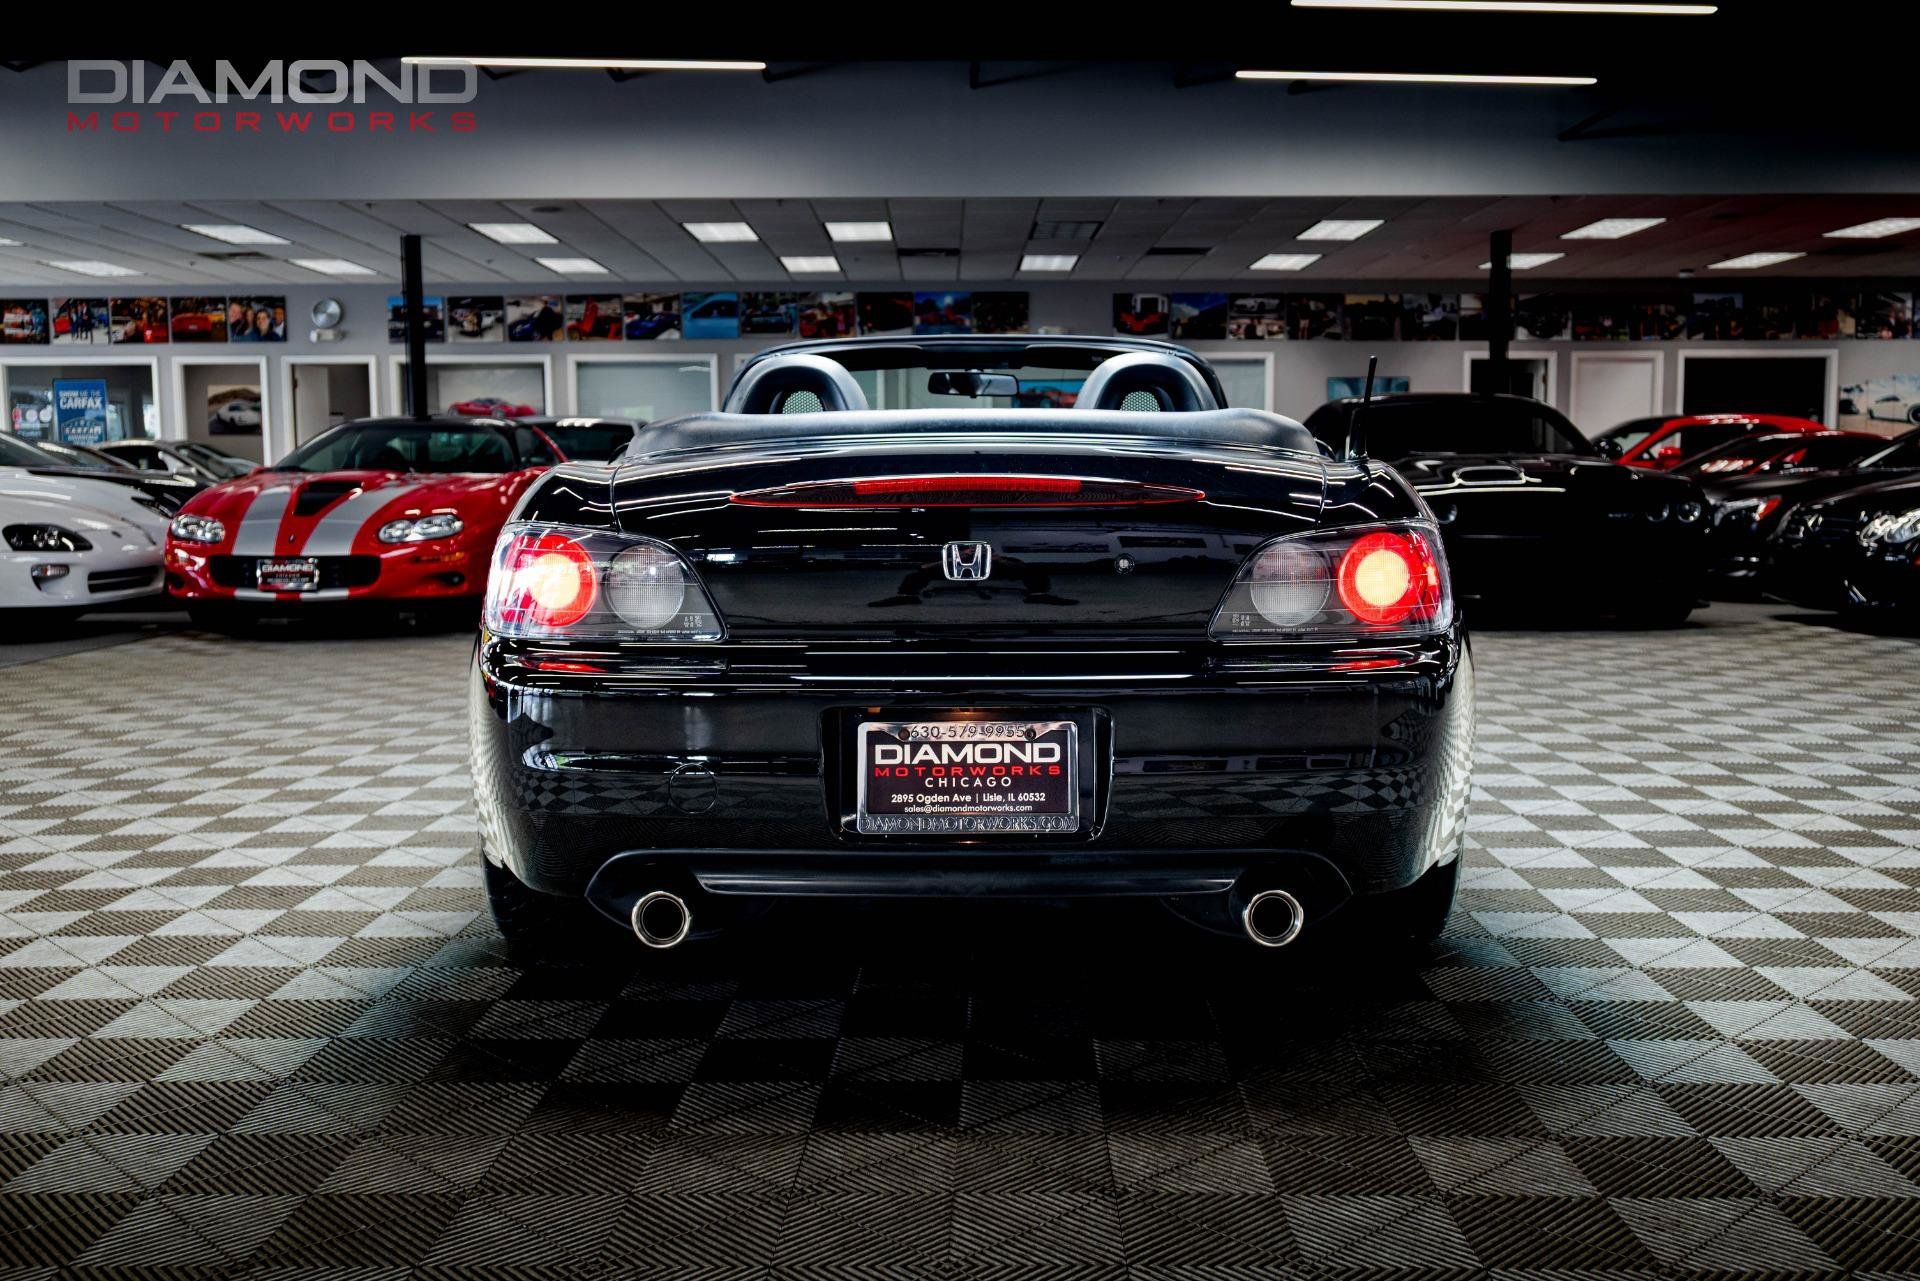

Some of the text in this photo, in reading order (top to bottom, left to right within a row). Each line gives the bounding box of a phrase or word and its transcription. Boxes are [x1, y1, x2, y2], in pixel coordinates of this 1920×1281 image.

[60, 397, 103, 410] CARFAX
[911, 725, 1025, 739] 630-579-9955
[875, 743, 1061, 765] DIAMOND
[874, 766, 1061, 777] MOTORWORKS
[924, 777, 1012, 788] CHICAGO
[891, 794, 914, 803] 2895
[916, 793, 950, 805] Ogden
[952, 793, 972, 802] Ave
[1008, 793, 1016, 802] IL
[1018, 793, 1046, 802] 60532
[904, 804, 1033, 813] sales@diamondmotorworks.com
